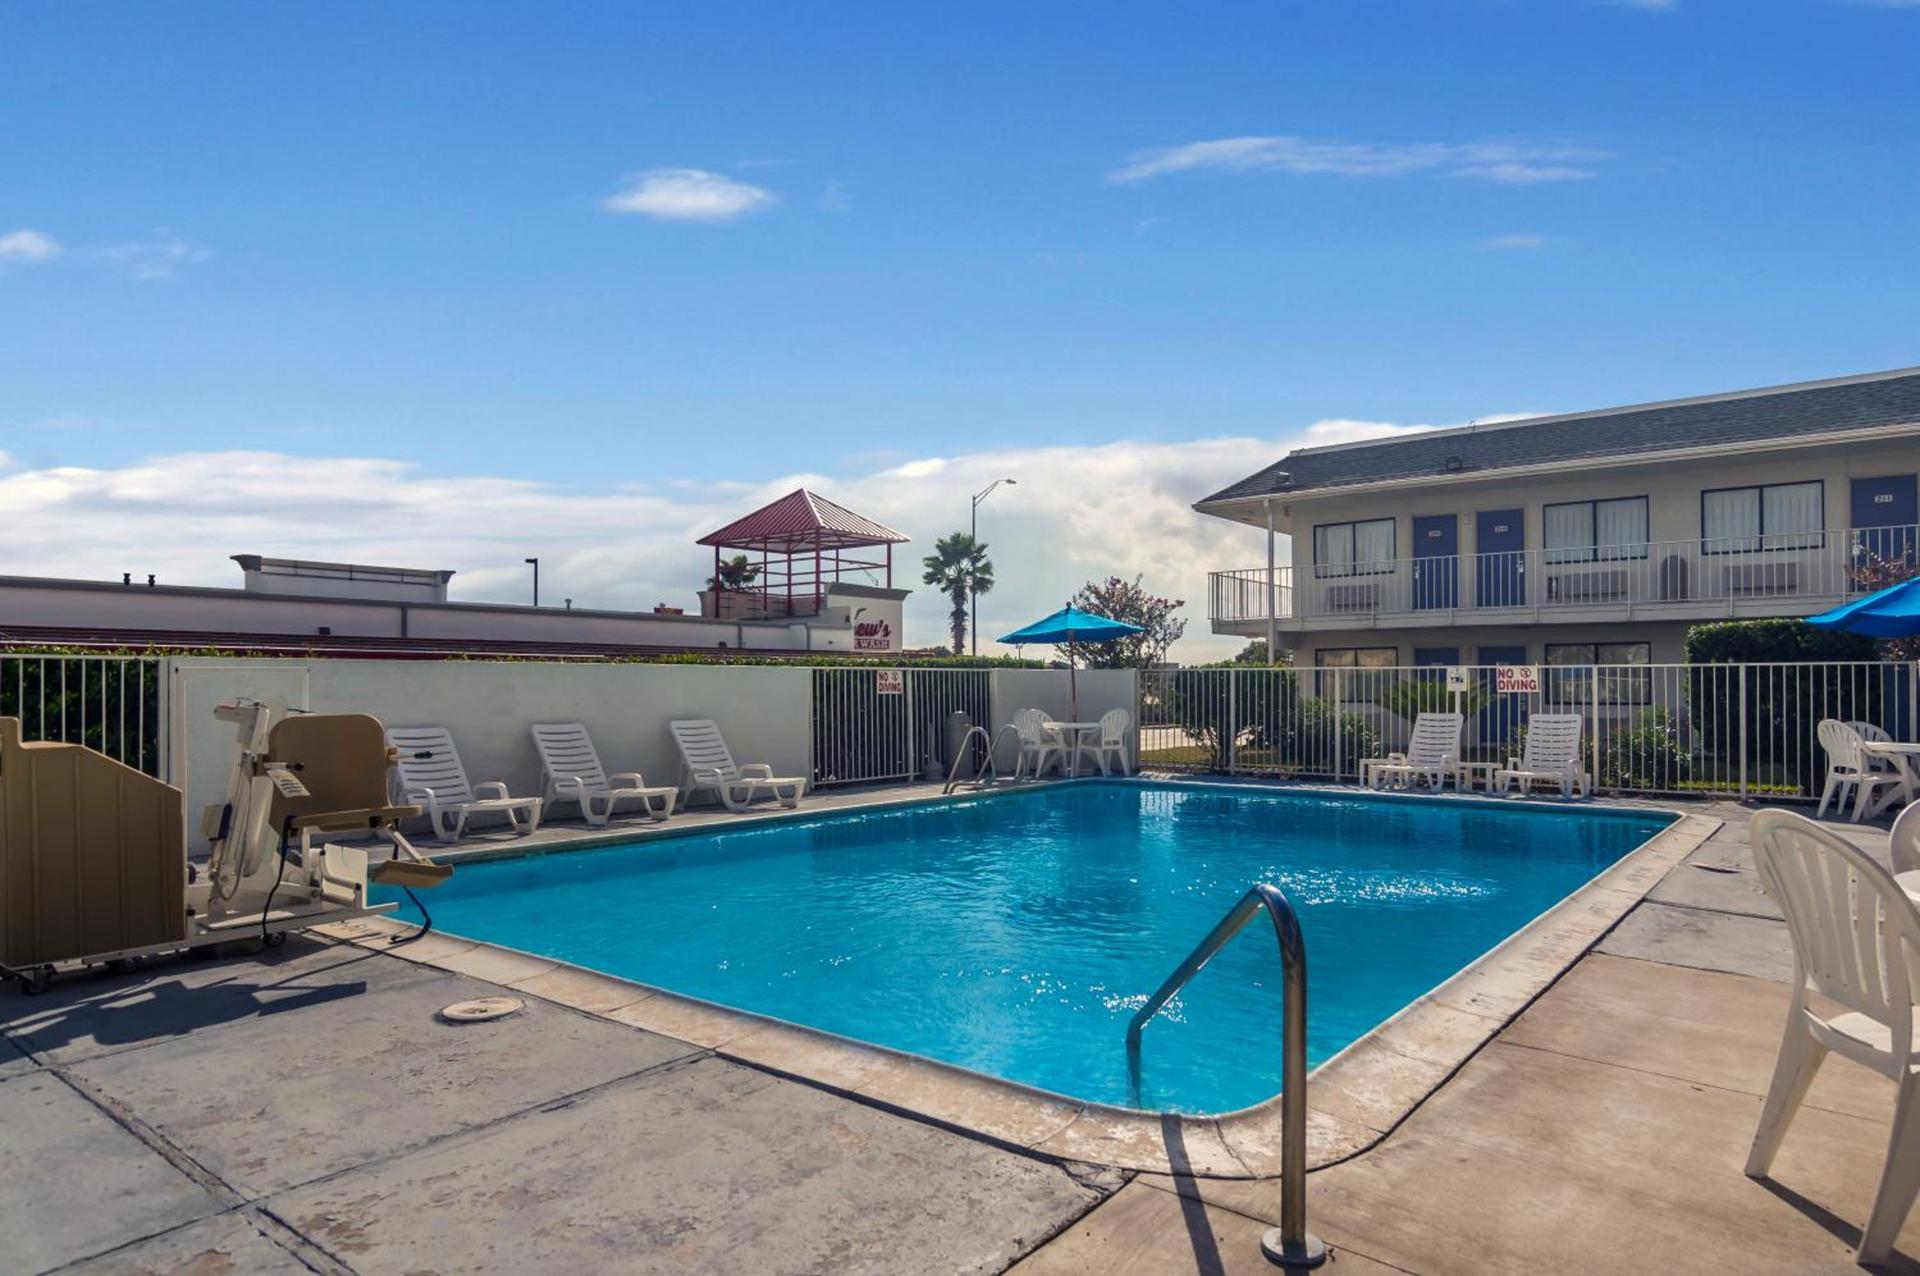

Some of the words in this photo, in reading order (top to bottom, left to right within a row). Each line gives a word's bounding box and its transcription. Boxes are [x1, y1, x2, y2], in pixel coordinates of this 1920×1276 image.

[855, 619, 891, 637] ew's
[861, 639, 888, 648] WASH
[879, 671, 888, 681] NO
[1498, 668, 1514, 678] NO
[879, 682, 901, 691] DIVING
[1498, 680, 1536, 690] DIVING
